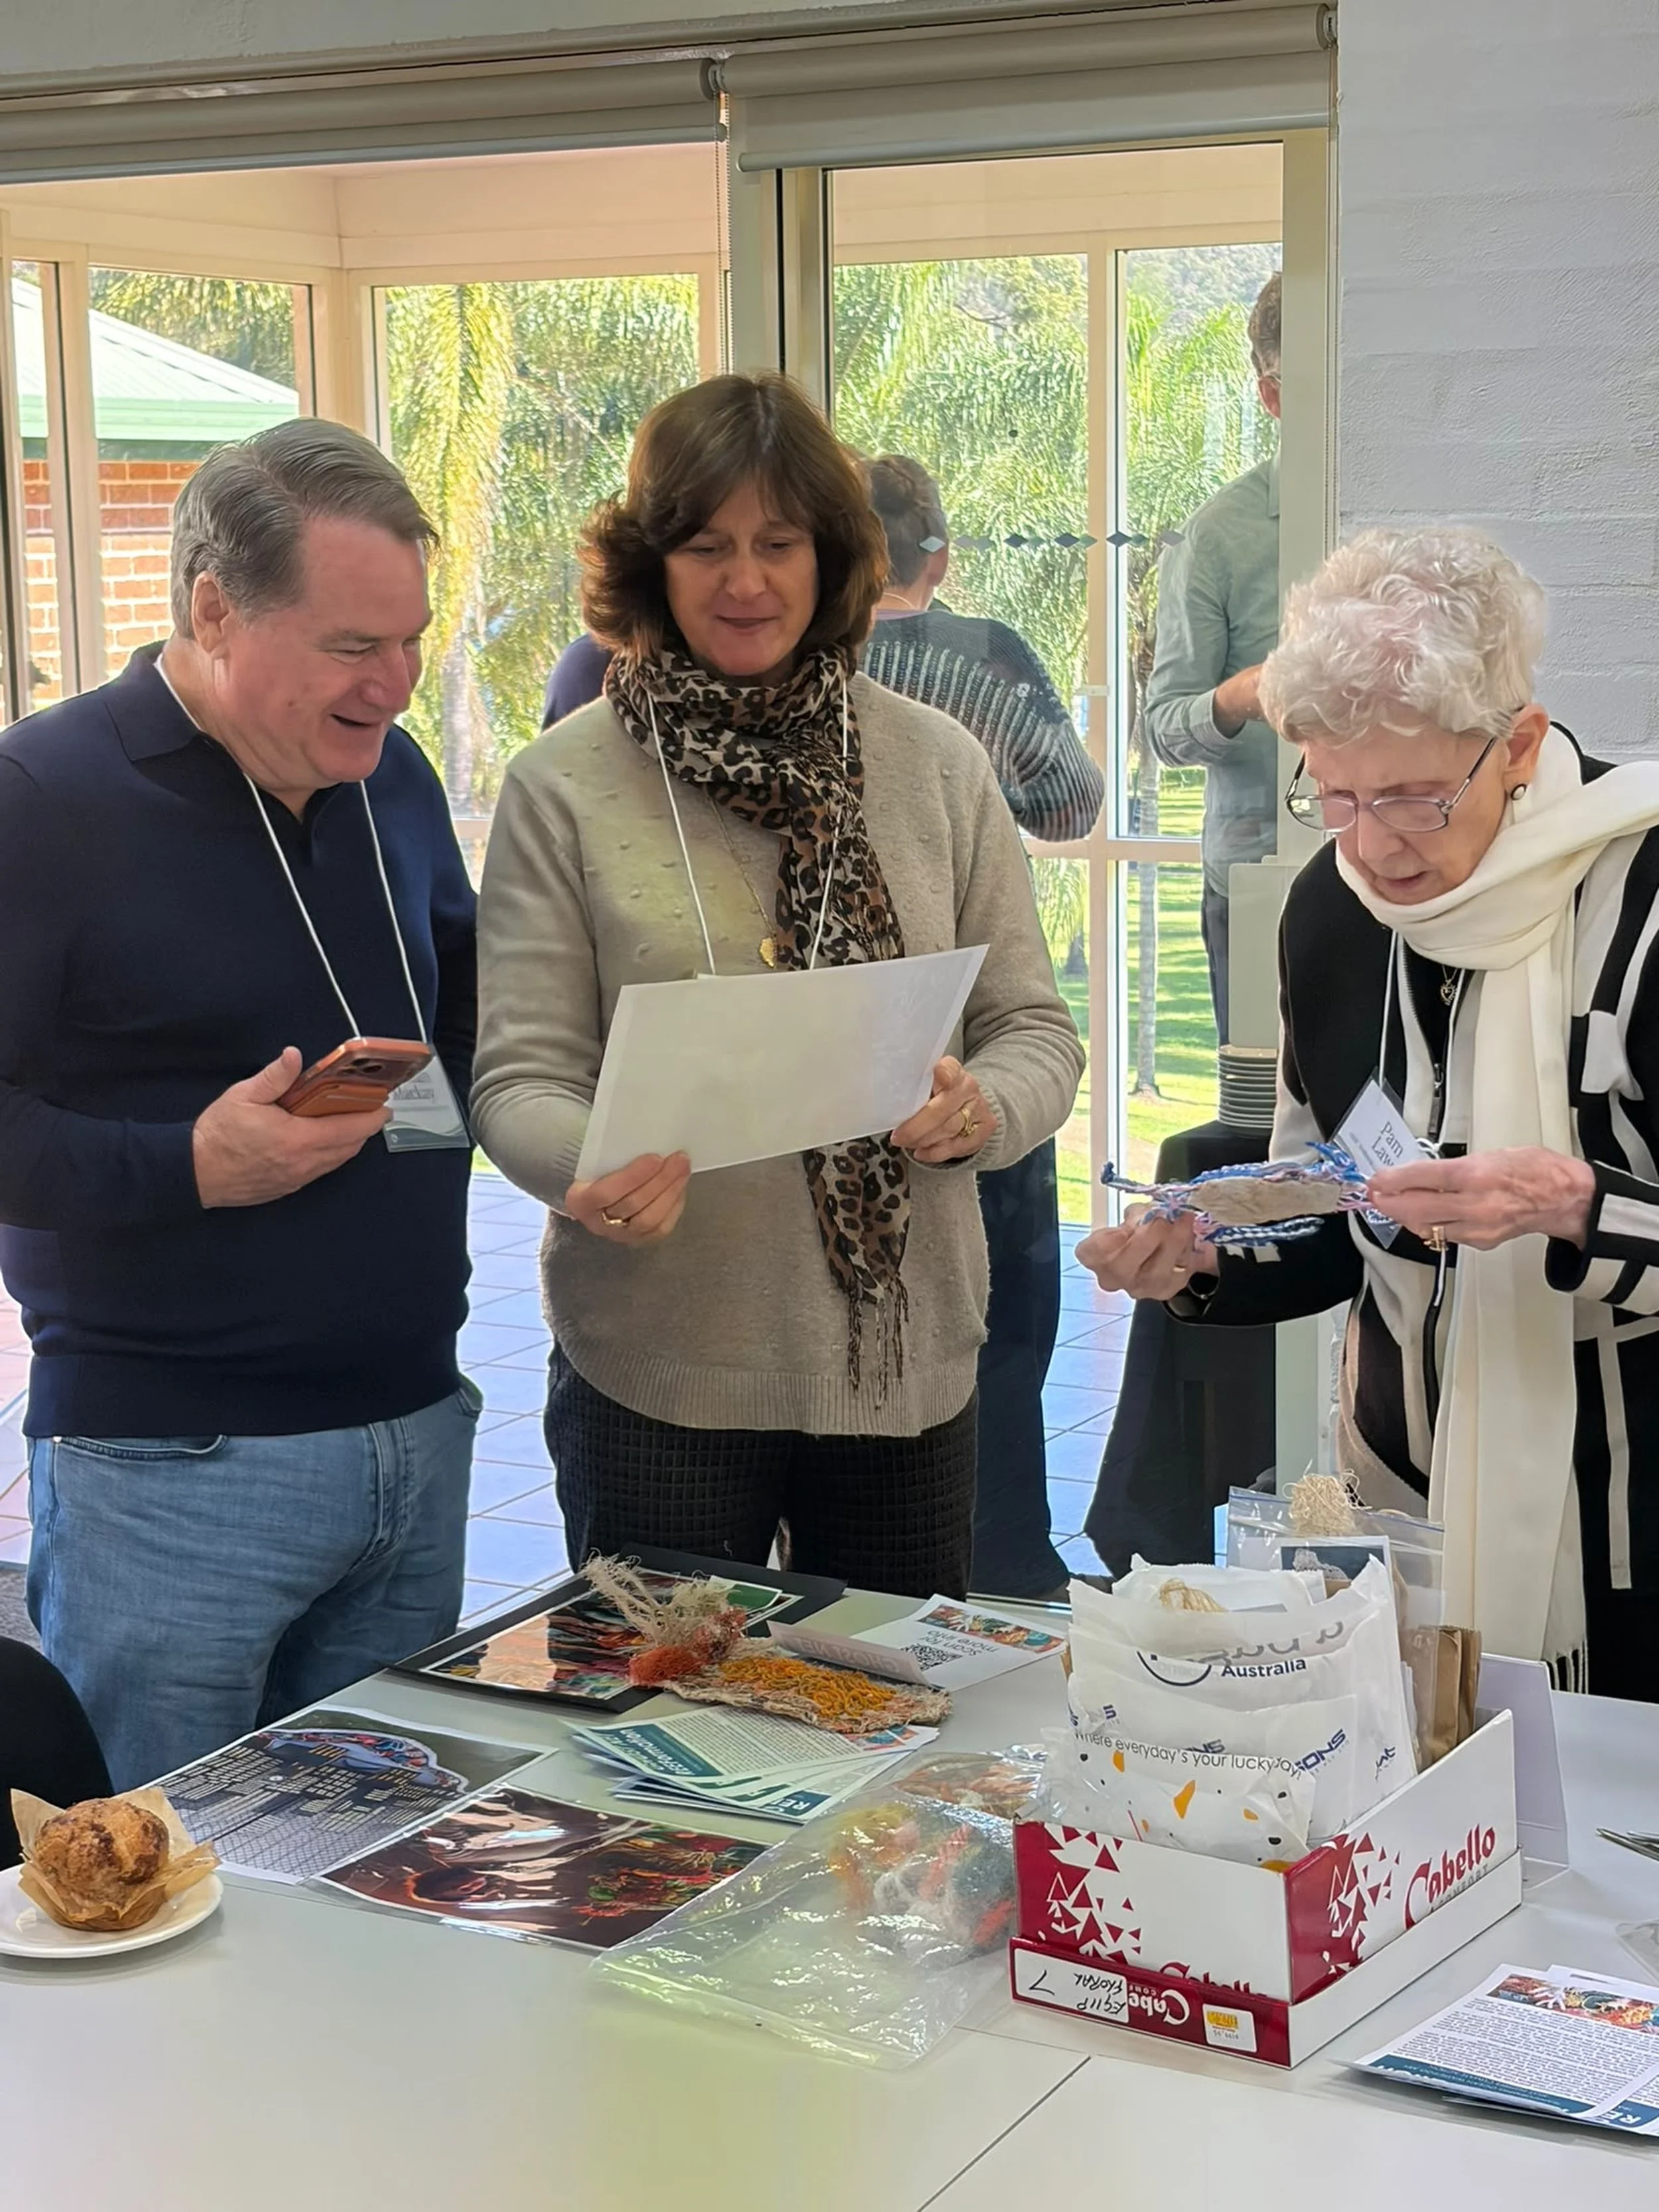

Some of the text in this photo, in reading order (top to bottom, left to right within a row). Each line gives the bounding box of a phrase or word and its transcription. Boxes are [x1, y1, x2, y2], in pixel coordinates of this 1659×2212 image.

[1380, 1120, 1404, 1159] Pam
[958, 1638, 1000, 1653] more
[1221, 1658, 1307, 1678] Australia
[1116, 1739, 1189, 1764] everyday's
[1192, 1753, 1227, 1768] your
[1232, 1753, 1276, 1775] lucky
[1404, 1822, 1496, 1930] Cabello
[1029, 1969, 1055, 1996] 7
[1072, 1973, 1123, 1996] FLORAL
